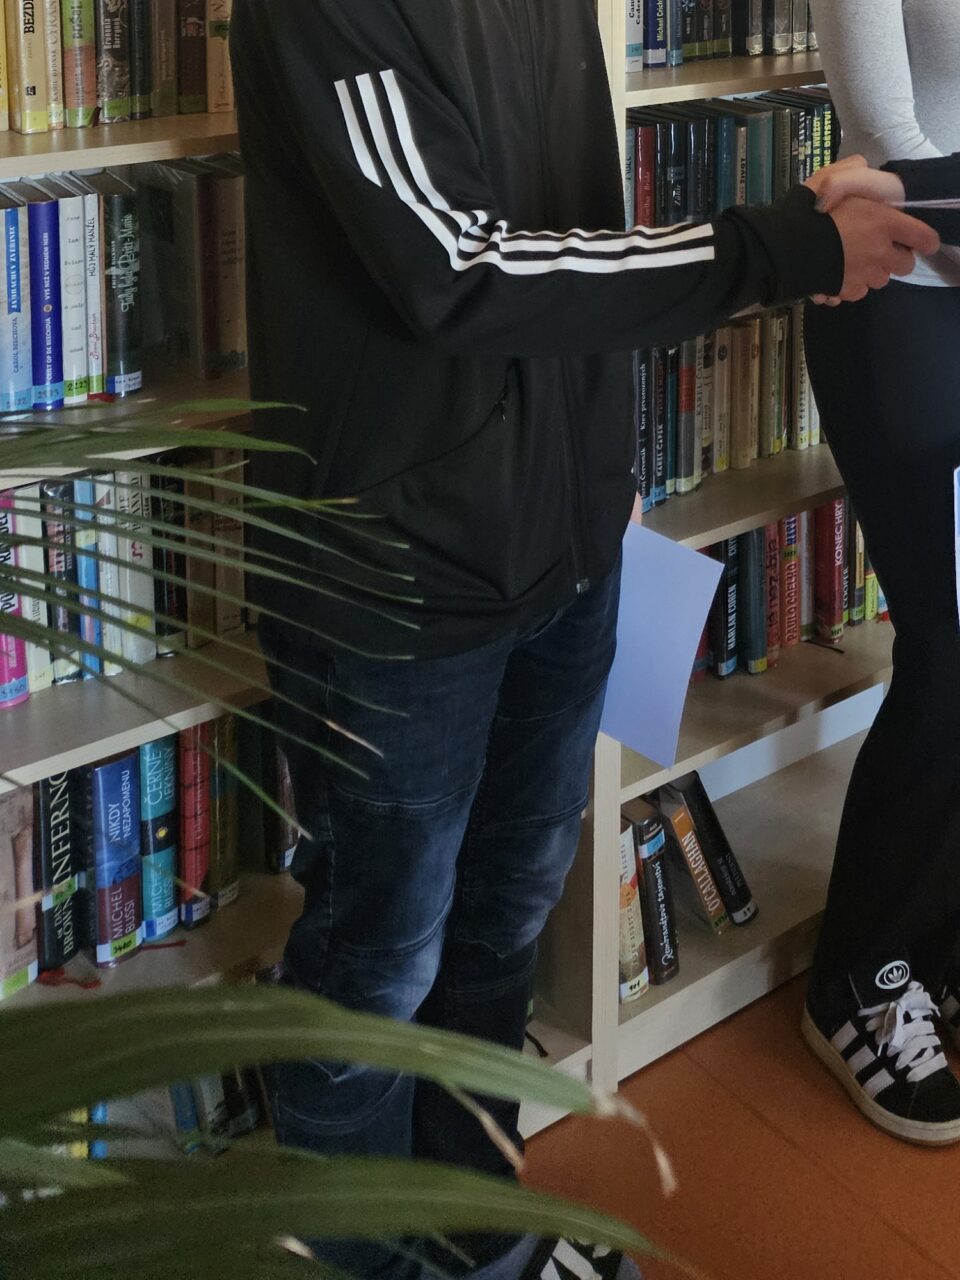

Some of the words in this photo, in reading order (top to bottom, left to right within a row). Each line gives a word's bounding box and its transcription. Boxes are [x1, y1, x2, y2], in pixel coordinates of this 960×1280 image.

[86, 217, 95, 242] MANŽEL
[834, 503, 843, 524] HRY
[834, 525, 843, 566] KONEC
[728, 584, 737, 614] COBEN
[784, 561, 797, 605] COELHO
[728, 615, 737, 650] HARLAN
[785, 607, 797, 640] PAULO
[144, 751, 163, 805] ČERNÉ
[108, 803, 121, 840] NIKDY
[121, 770, 132, 837] NEZAPOMENU
[681, 831, 720, 911] O'CALLAGHAN
[62, 896, 74, 955] BROWN
[111, 888, 124, 939] MICHEL
[125, 900, 136, 933] BUSSI
[659, 903, 674, 965] Rembrandtovo
